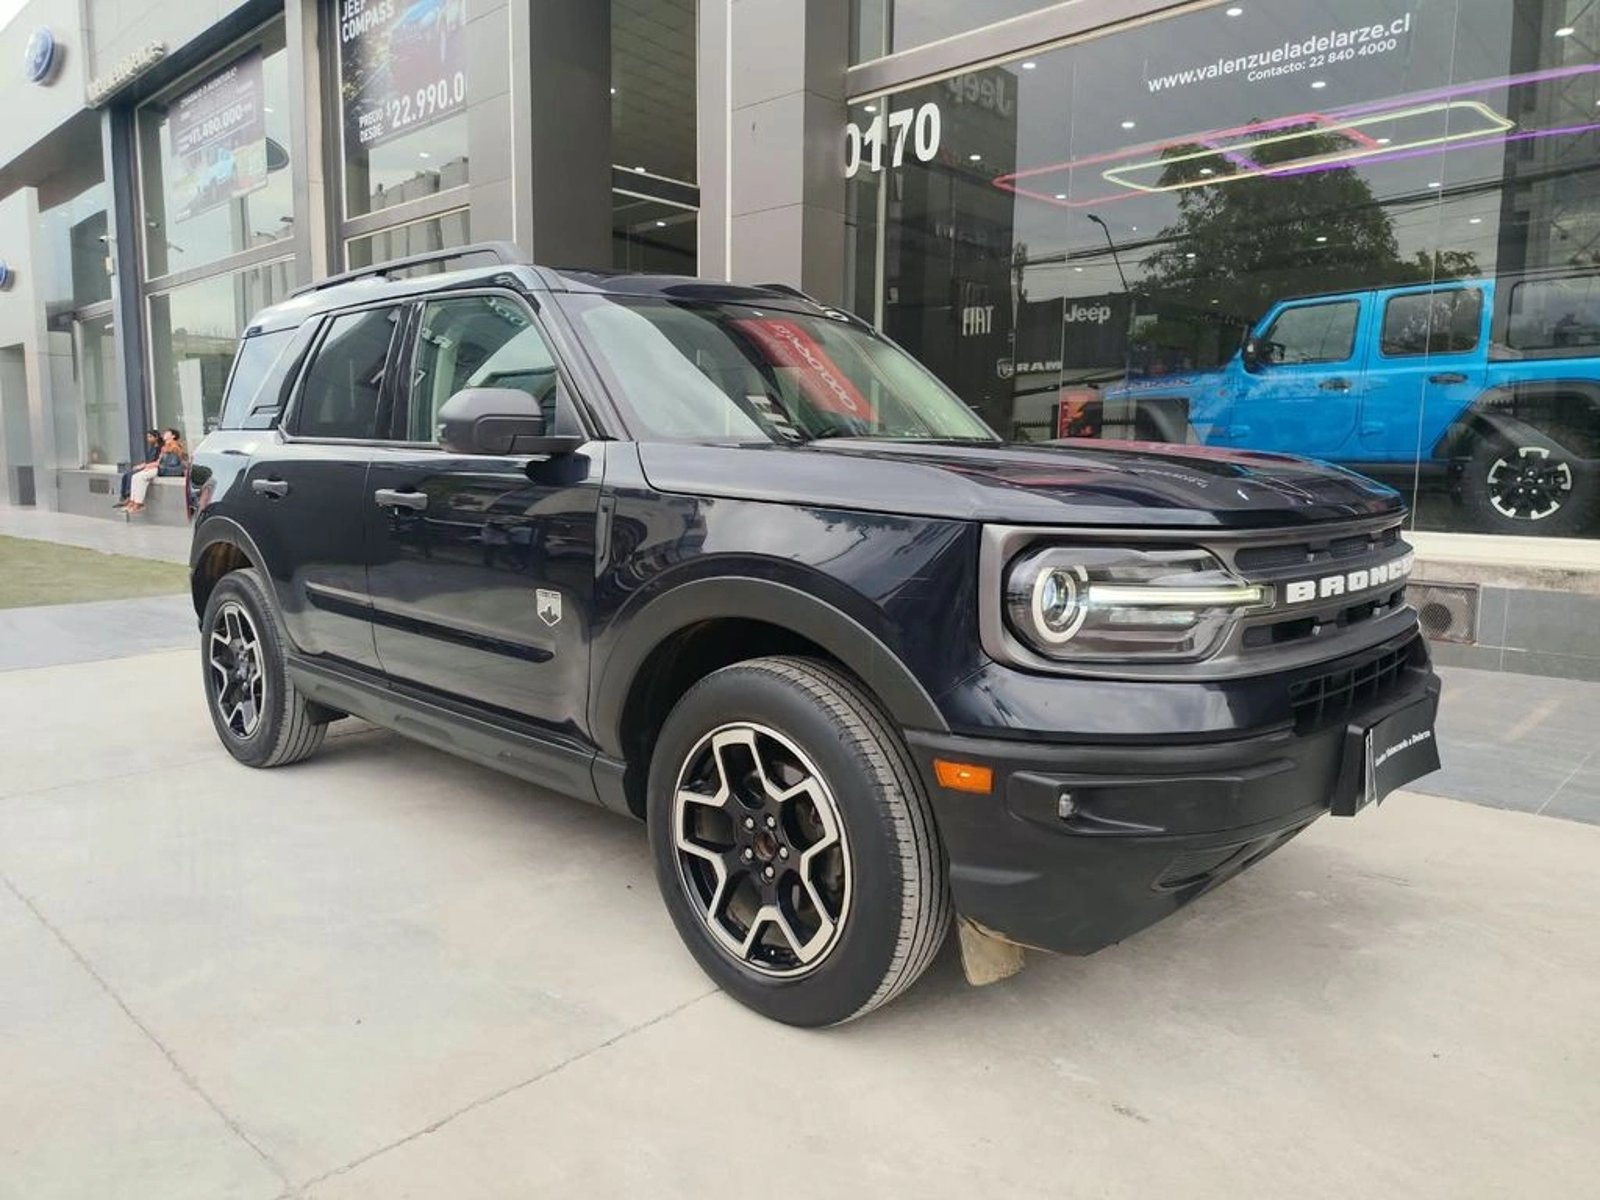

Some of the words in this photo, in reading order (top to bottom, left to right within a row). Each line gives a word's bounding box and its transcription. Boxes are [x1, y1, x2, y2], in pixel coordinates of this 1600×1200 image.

[341, 0, 395, 42] COMPASS
[1147, 12, 1411, 93] www.valenzueladelarze.cl
[1247, 61, 1306, 82] Contacto:
[1309, 57, 1325, 69] 22
[1327, 48, 1355, 64] 840
[1358, 38, 1397, 58] 4000
[385, 71, 468, 128] $22.990.0
[962, 305, 994, 336] FIAT
[1065, 304, 1111, 325] Jeep
[1016, 361, 1062, 372] RAM
